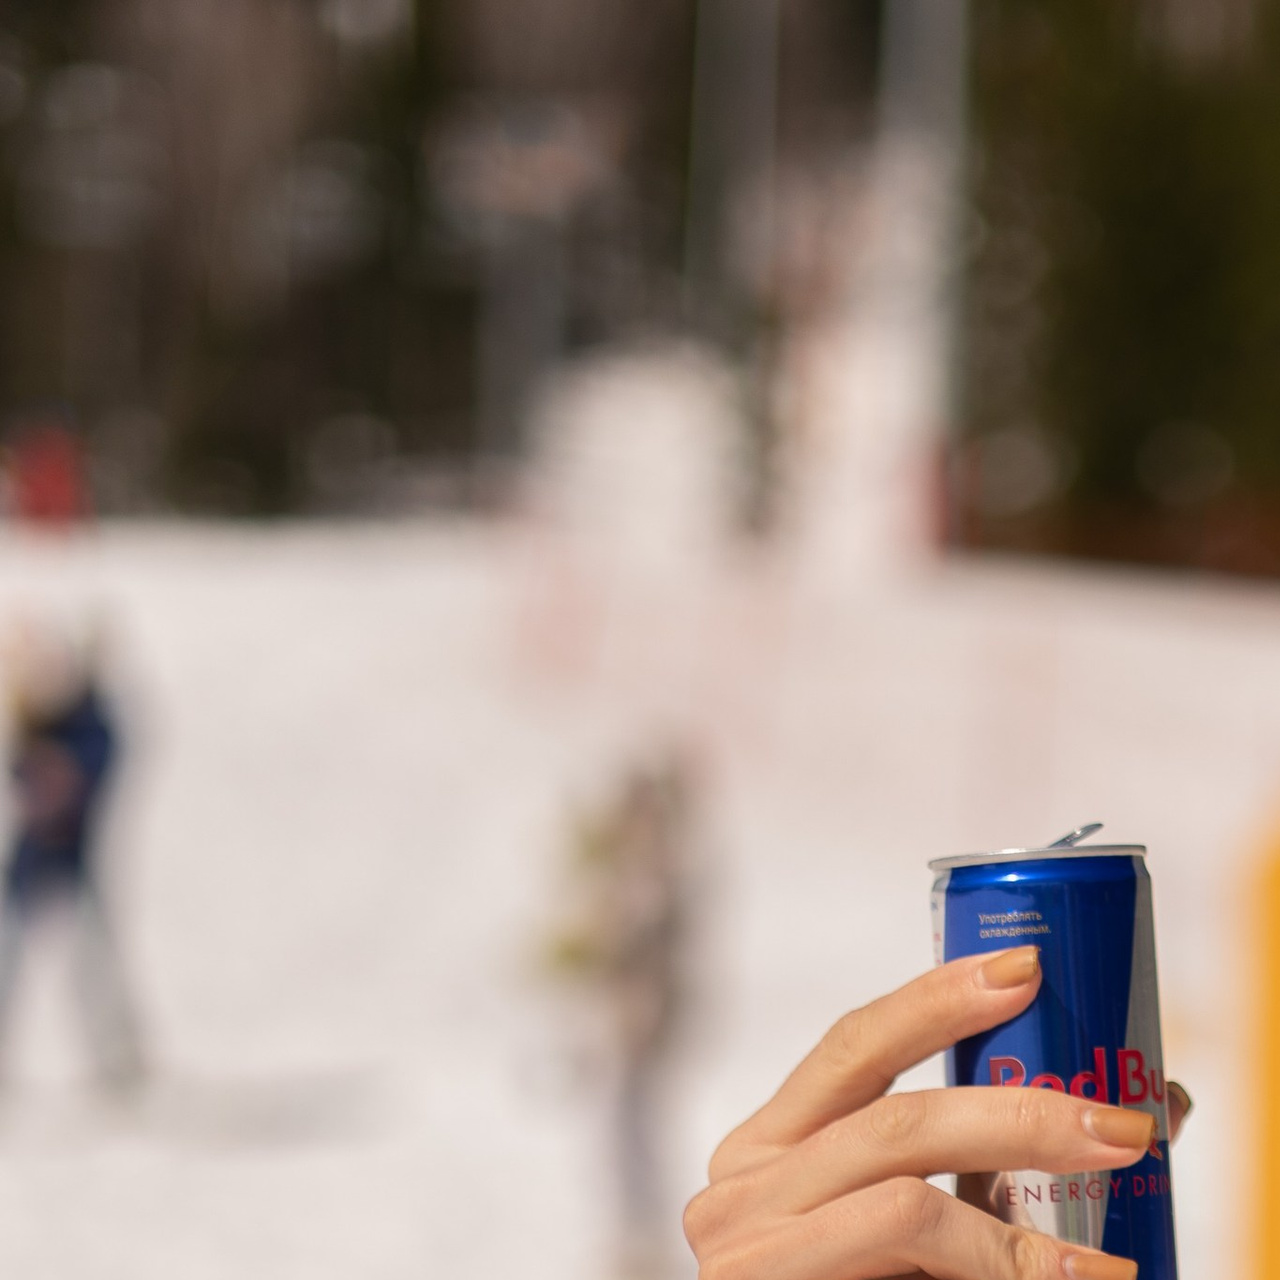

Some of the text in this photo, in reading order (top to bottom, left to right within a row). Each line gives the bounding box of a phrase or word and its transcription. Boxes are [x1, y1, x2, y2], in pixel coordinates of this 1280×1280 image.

[978, 909, 1043, 926] Употреблять
[979, 923, 1052, 939] охлажденным.
[1116, 1048, 1164, 1106] Bu
[1006, 1174, 1171, 1206] ENERGY DRIN
